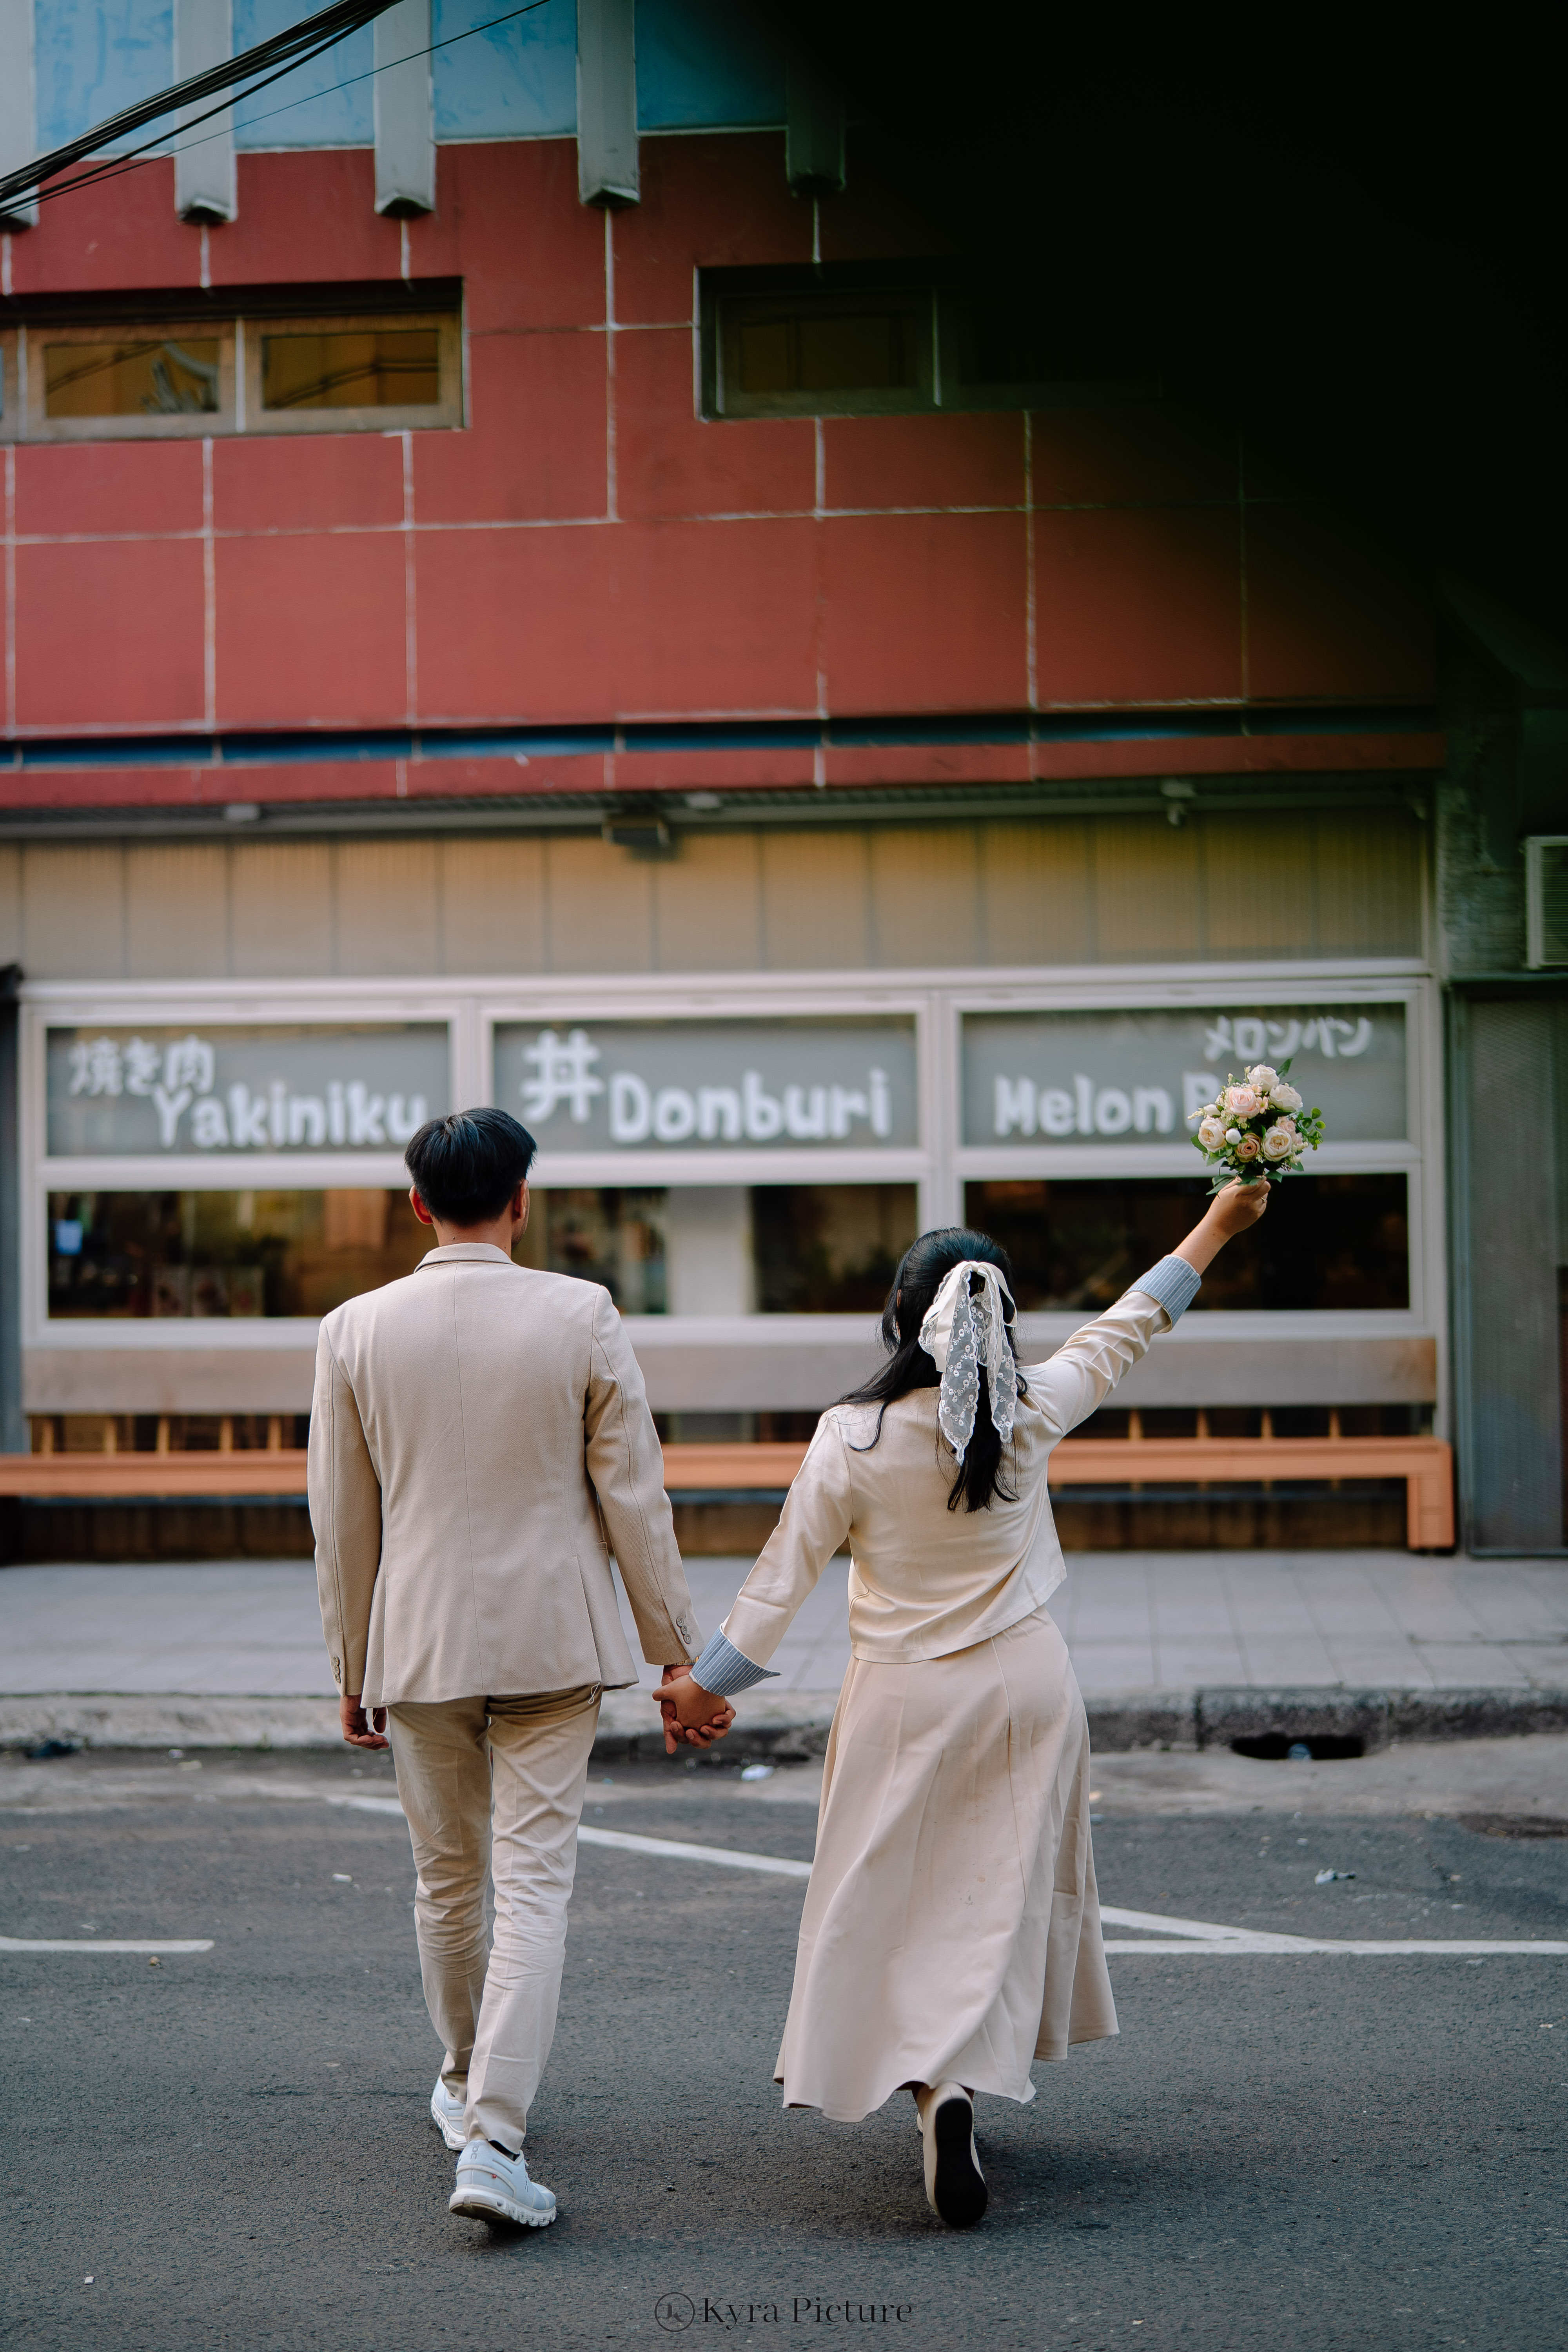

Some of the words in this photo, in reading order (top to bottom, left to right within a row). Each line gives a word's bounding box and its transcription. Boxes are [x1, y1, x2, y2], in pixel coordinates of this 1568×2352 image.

[68, 1036, 214, 1096] 焼き肉
[1204, 1016, 1371, 1060] メロンパン
[153, 1080, 427, 1147] Yakiniku
[610, 1067, 890, 1141] Donburi
[995, 1073, 1172, 1136] Melon
